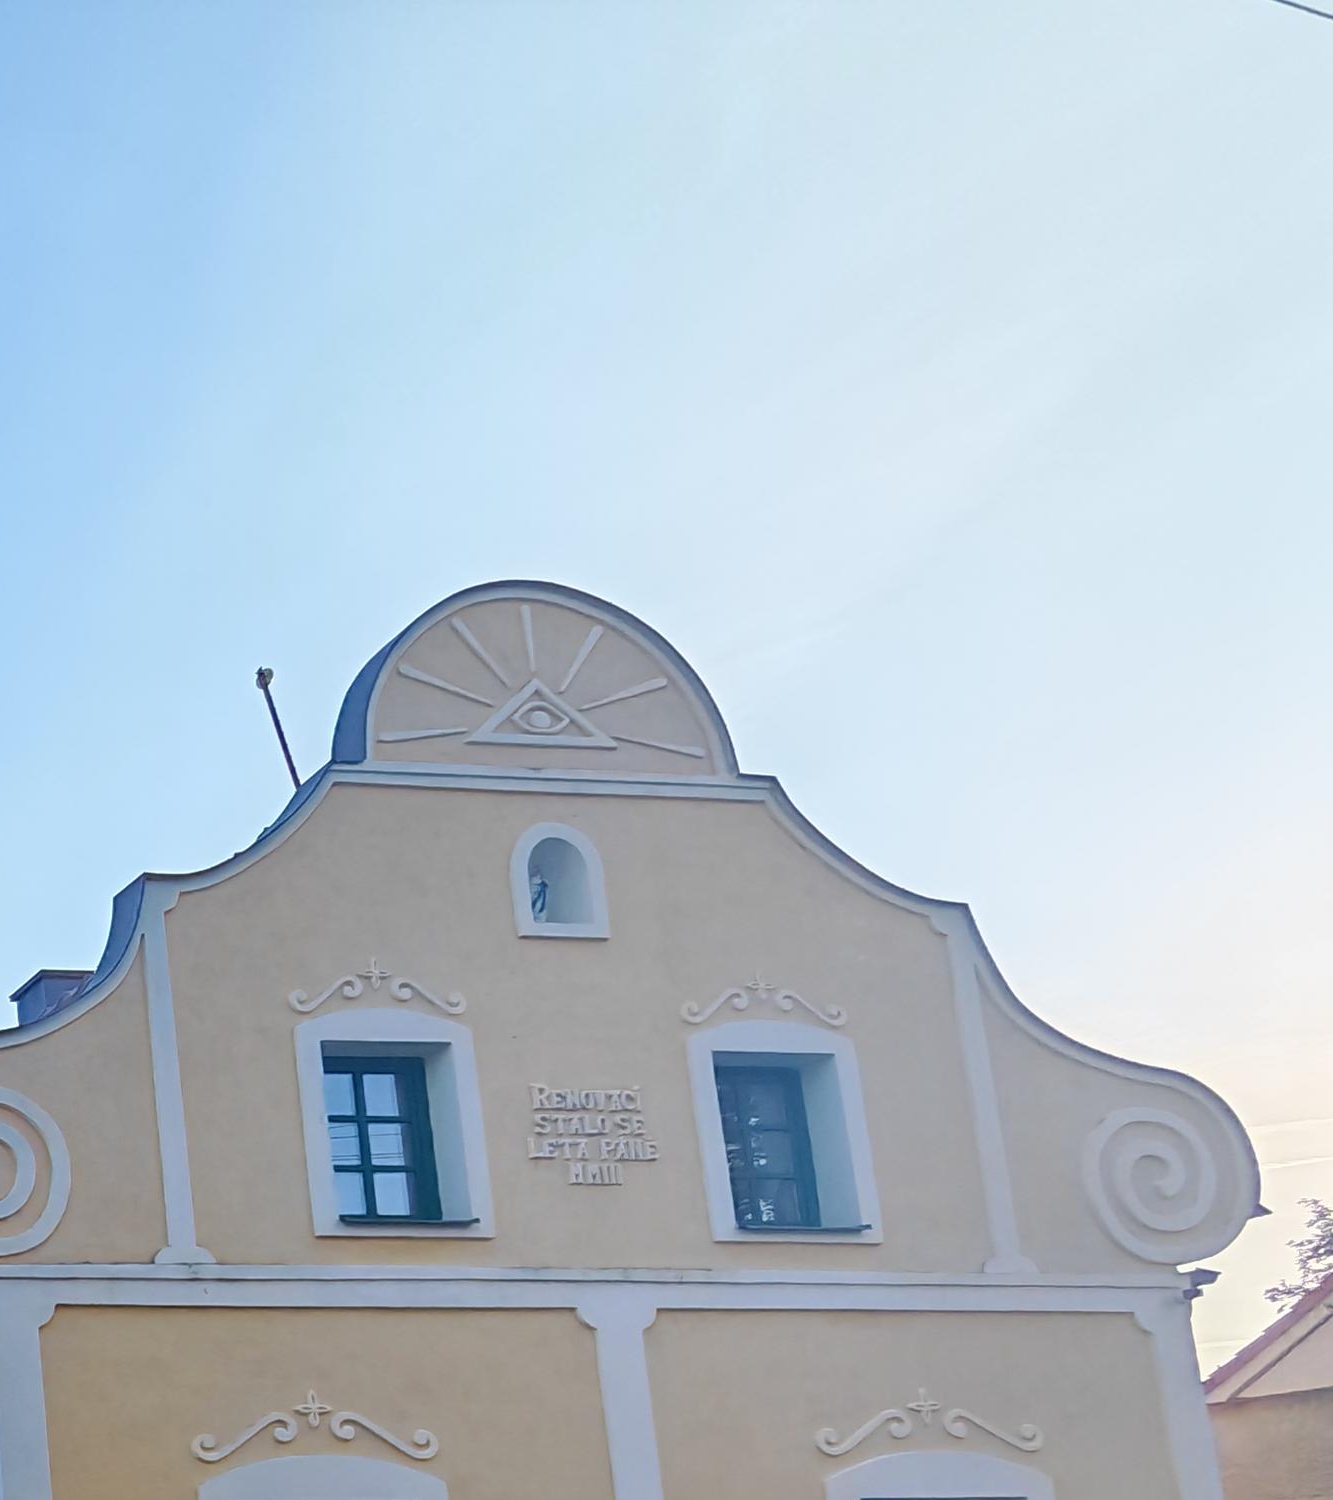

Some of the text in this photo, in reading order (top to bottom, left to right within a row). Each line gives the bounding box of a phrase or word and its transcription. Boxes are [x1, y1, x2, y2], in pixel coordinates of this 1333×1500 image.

[528, 1082, 641, 1112] RENOVACÍ
[533, 1114, 646, 1136] STALO SE
